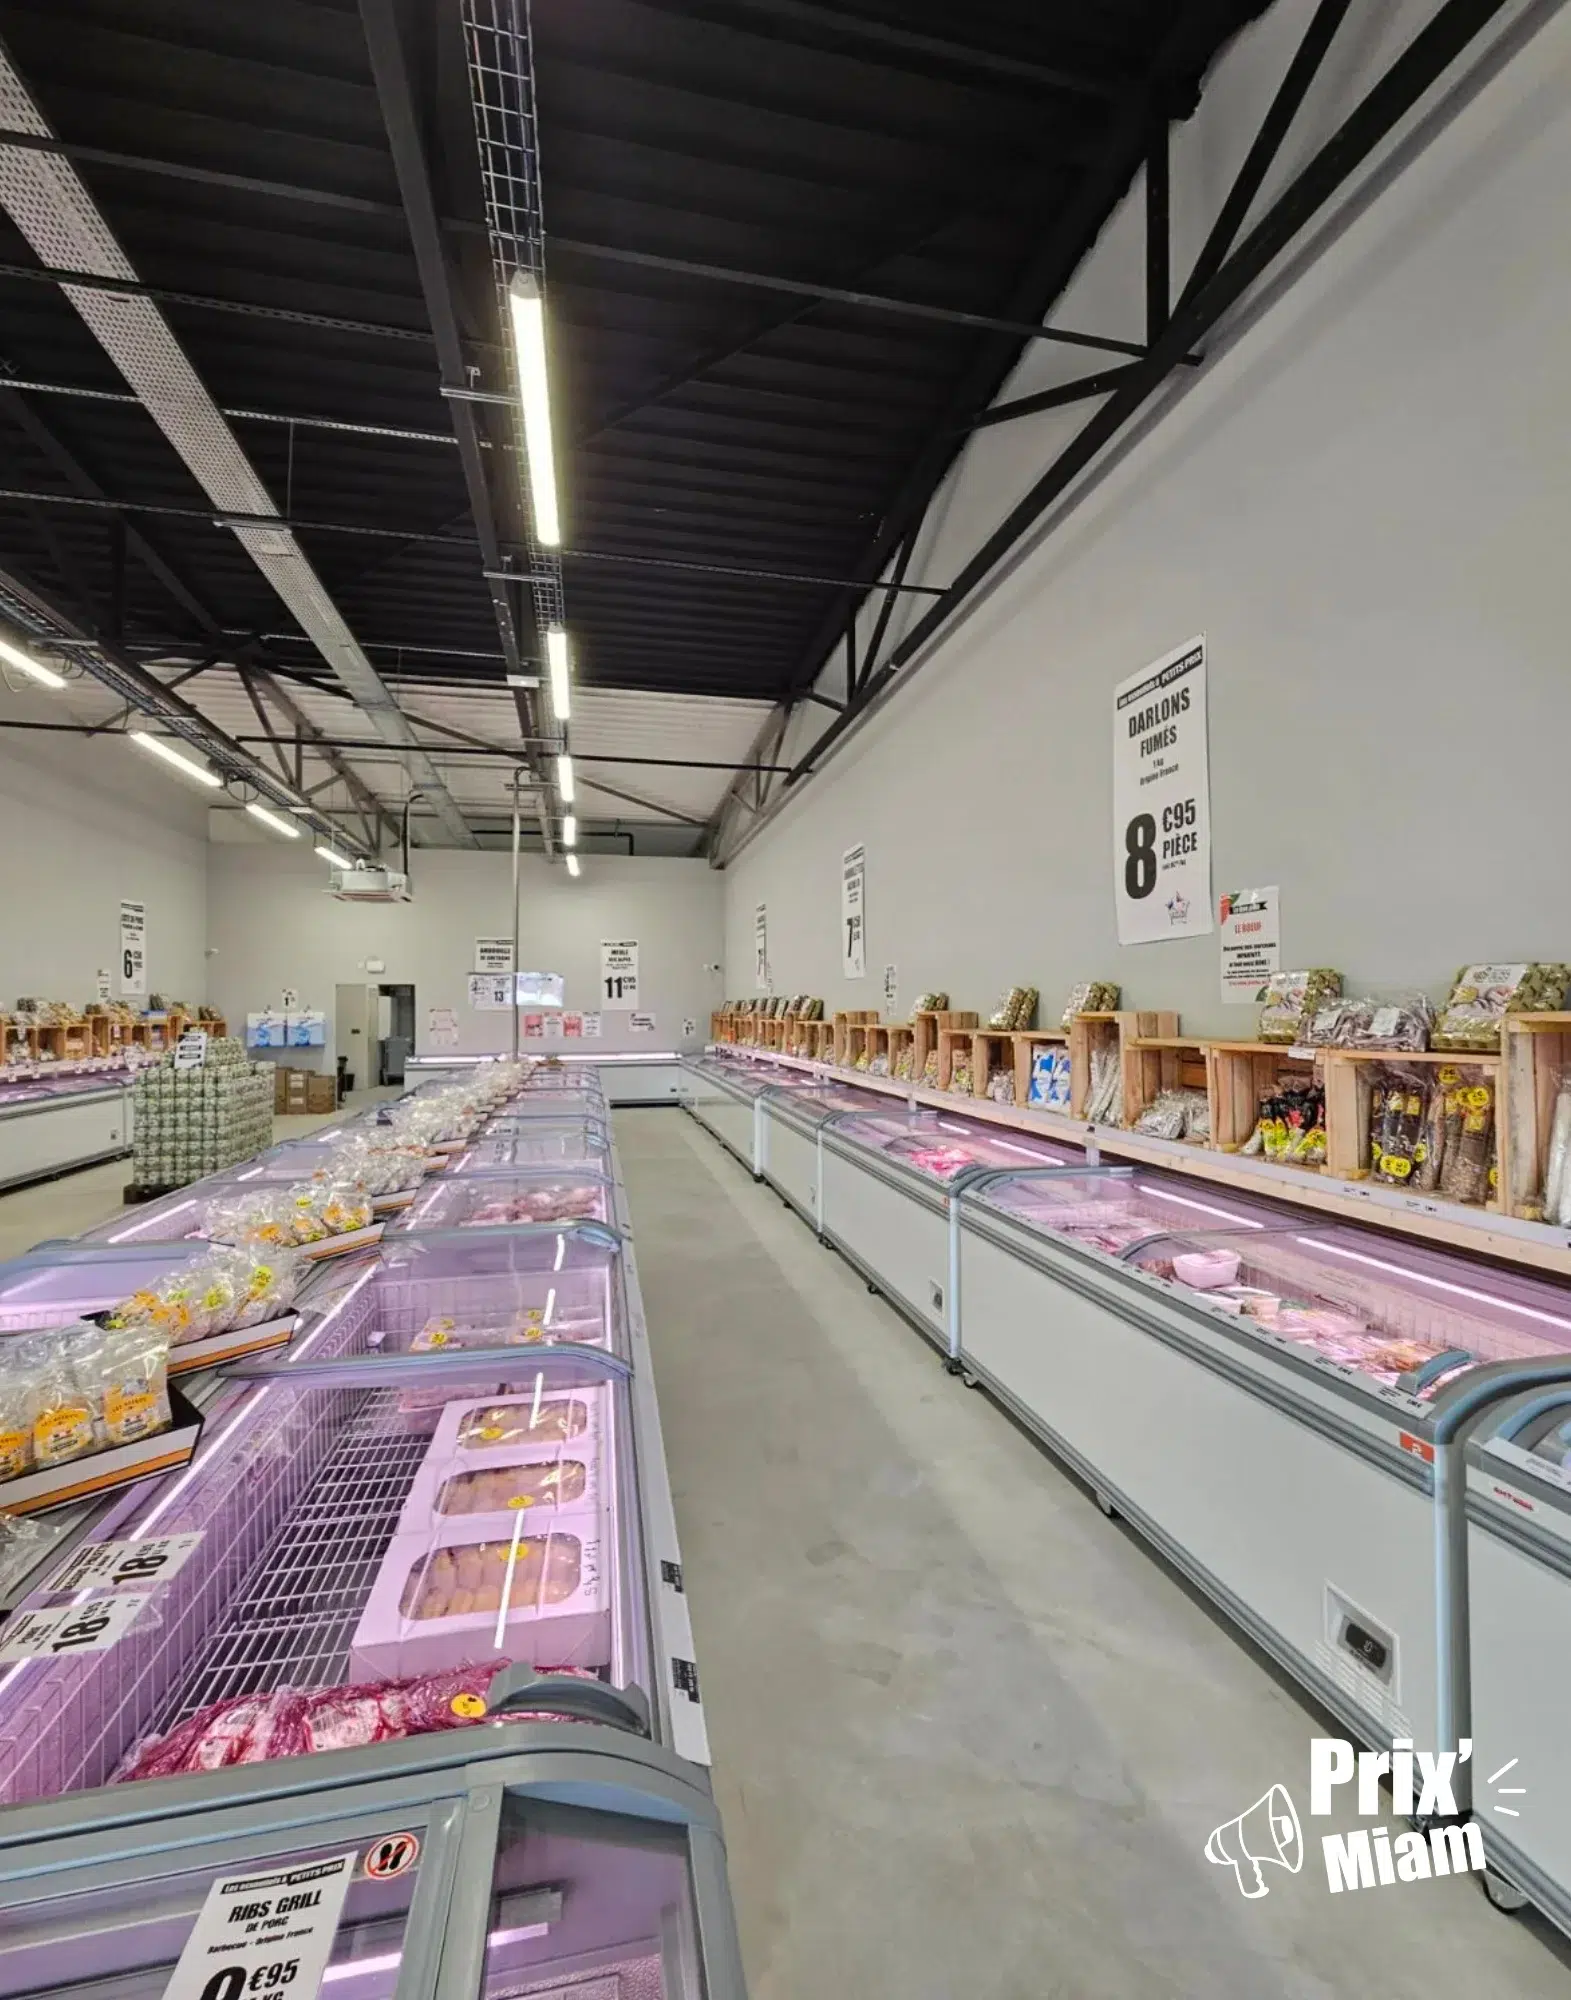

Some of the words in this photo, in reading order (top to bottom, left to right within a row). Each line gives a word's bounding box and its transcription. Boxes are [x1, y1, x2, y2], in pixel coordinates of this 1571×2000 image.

[1128, 686, 1191, 739] DARLONS
[1140, 724, 1178, 758] FUMÉS
[1125, 813, 1157, 900] 8
[1162, 832, 1198, 860] PIÈCE
[124, 949, 133, 979] 6
[495, 991, 504, 1002] 13
[604, 976, 623, 999] 11
[111, 1554, 169, 1586] 18
[52, 1616, 110, 1652] 18
[290, 1868, 322, 1881] PETITS
[322, 1862, 343, 1875] PRIX
[227, 1900, 272, 1923] RIBS
[275, 1889, 322, 1914] GRILL
[207, 1941, 248, 1954] Barbecue
[255, 1934, 285, 1946] Origine
[286, 1926, 314, 1938] France
[245, 1921, 259, 1933] DE
[261, 1916, 290, 1931] PORC
[247, 1957, 301, 1992] €95
